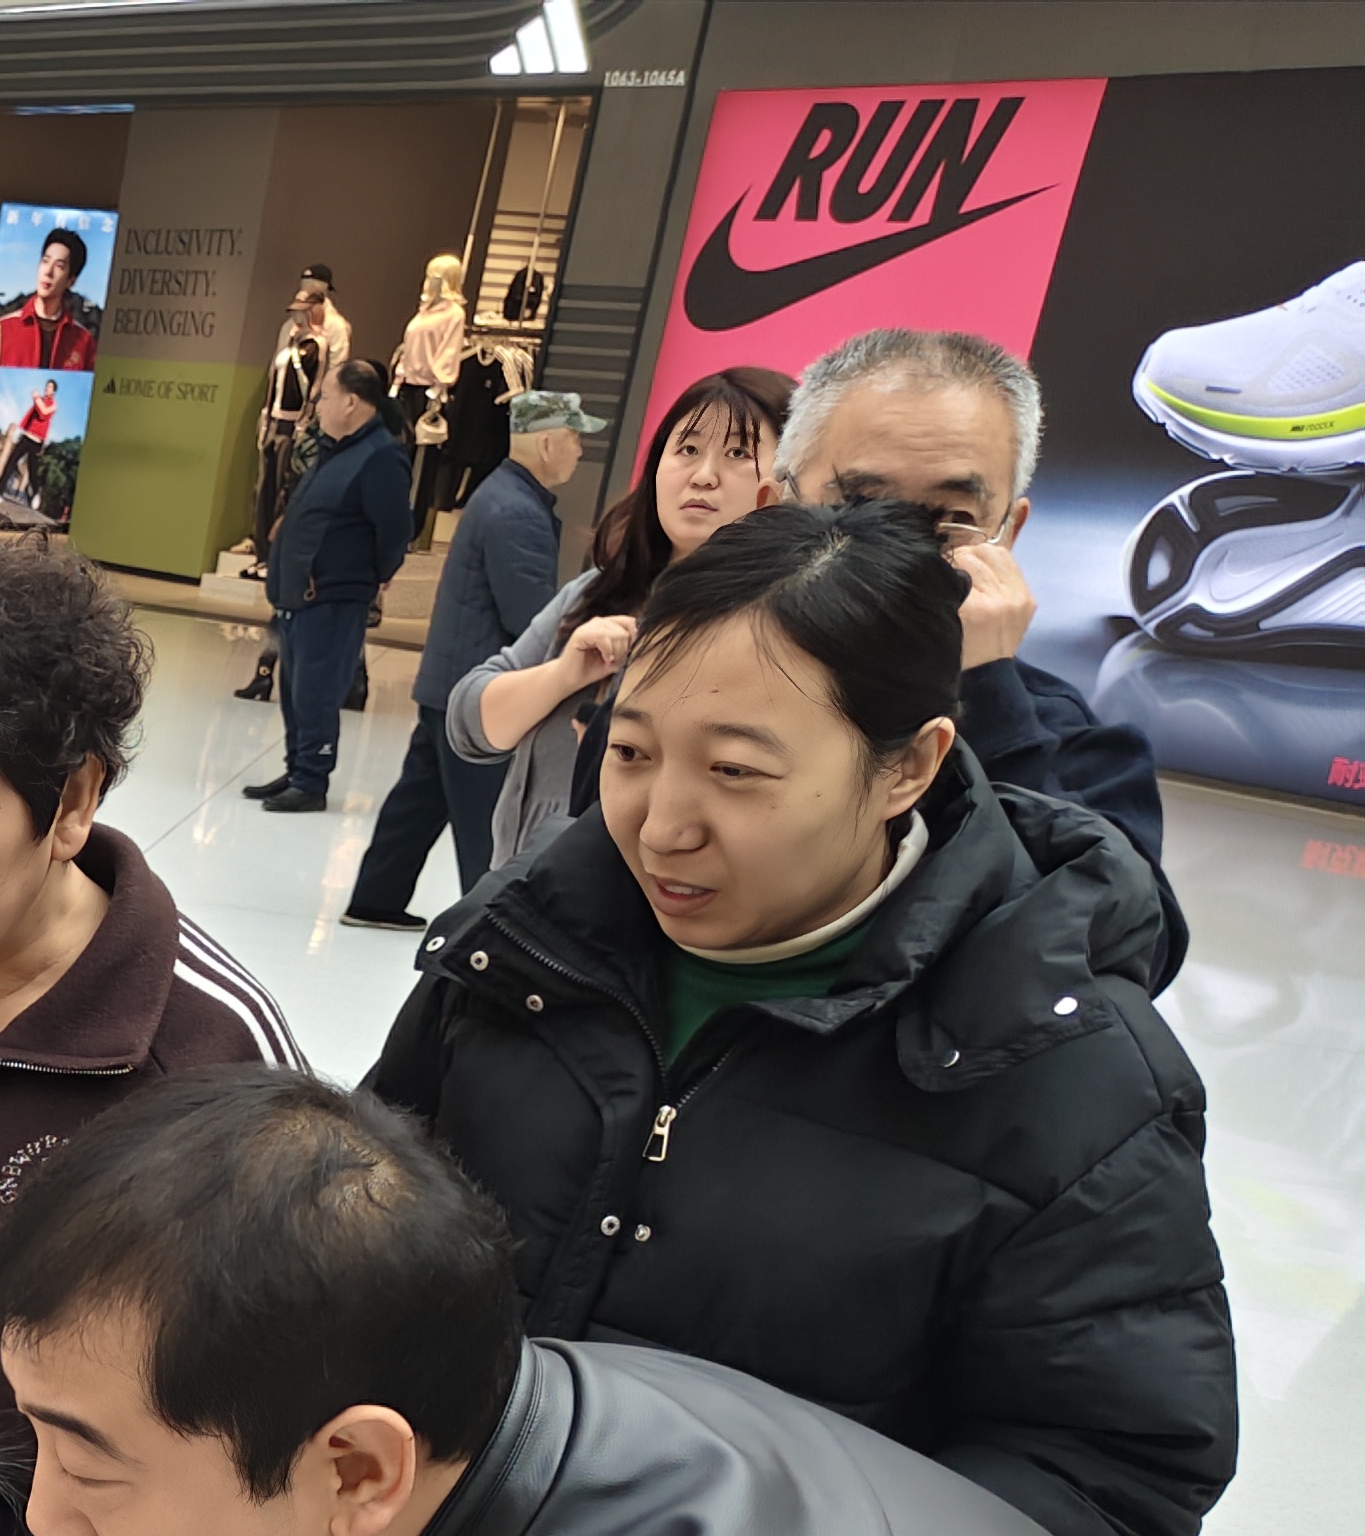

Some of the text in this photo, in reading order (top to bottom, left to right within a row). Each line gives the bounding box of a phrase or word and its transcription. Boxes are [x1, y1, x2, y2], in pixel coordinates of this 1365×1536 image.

[755, 96, 1026, 224] RUN
[125, 229, 243, 256] INCLUSIVITY.
[119, 269, 217, 297] DIVERSITY.
[113, 309, 215, 338] BELONGING
[118, 377, 218, 402] HOME OF SPORT
